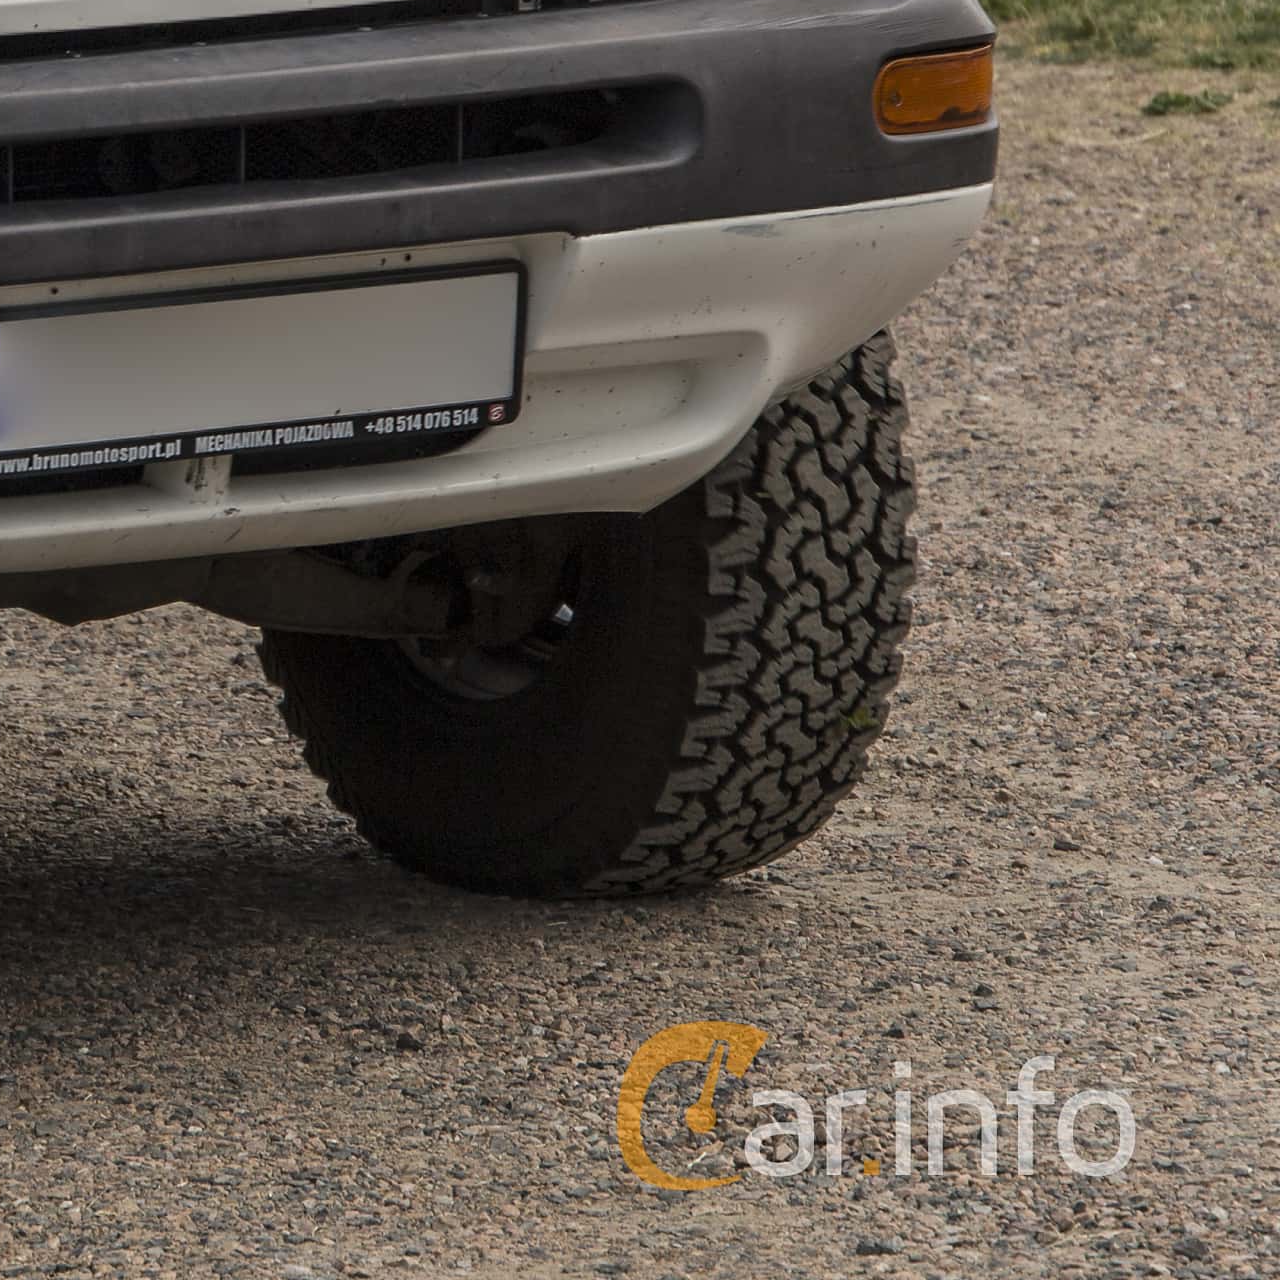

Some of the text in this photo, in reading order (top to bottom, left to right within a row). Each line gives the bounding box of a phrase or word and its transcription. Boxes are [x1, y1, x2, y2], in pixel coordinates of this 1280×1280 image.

[195, 429, 273, 454] MECHANIKA
[365, 417, 394, 435] +48
[396, 415, 423, 433] 514
[424, 411, 451, 430] 076
[452, 407, 479, 427] 514
